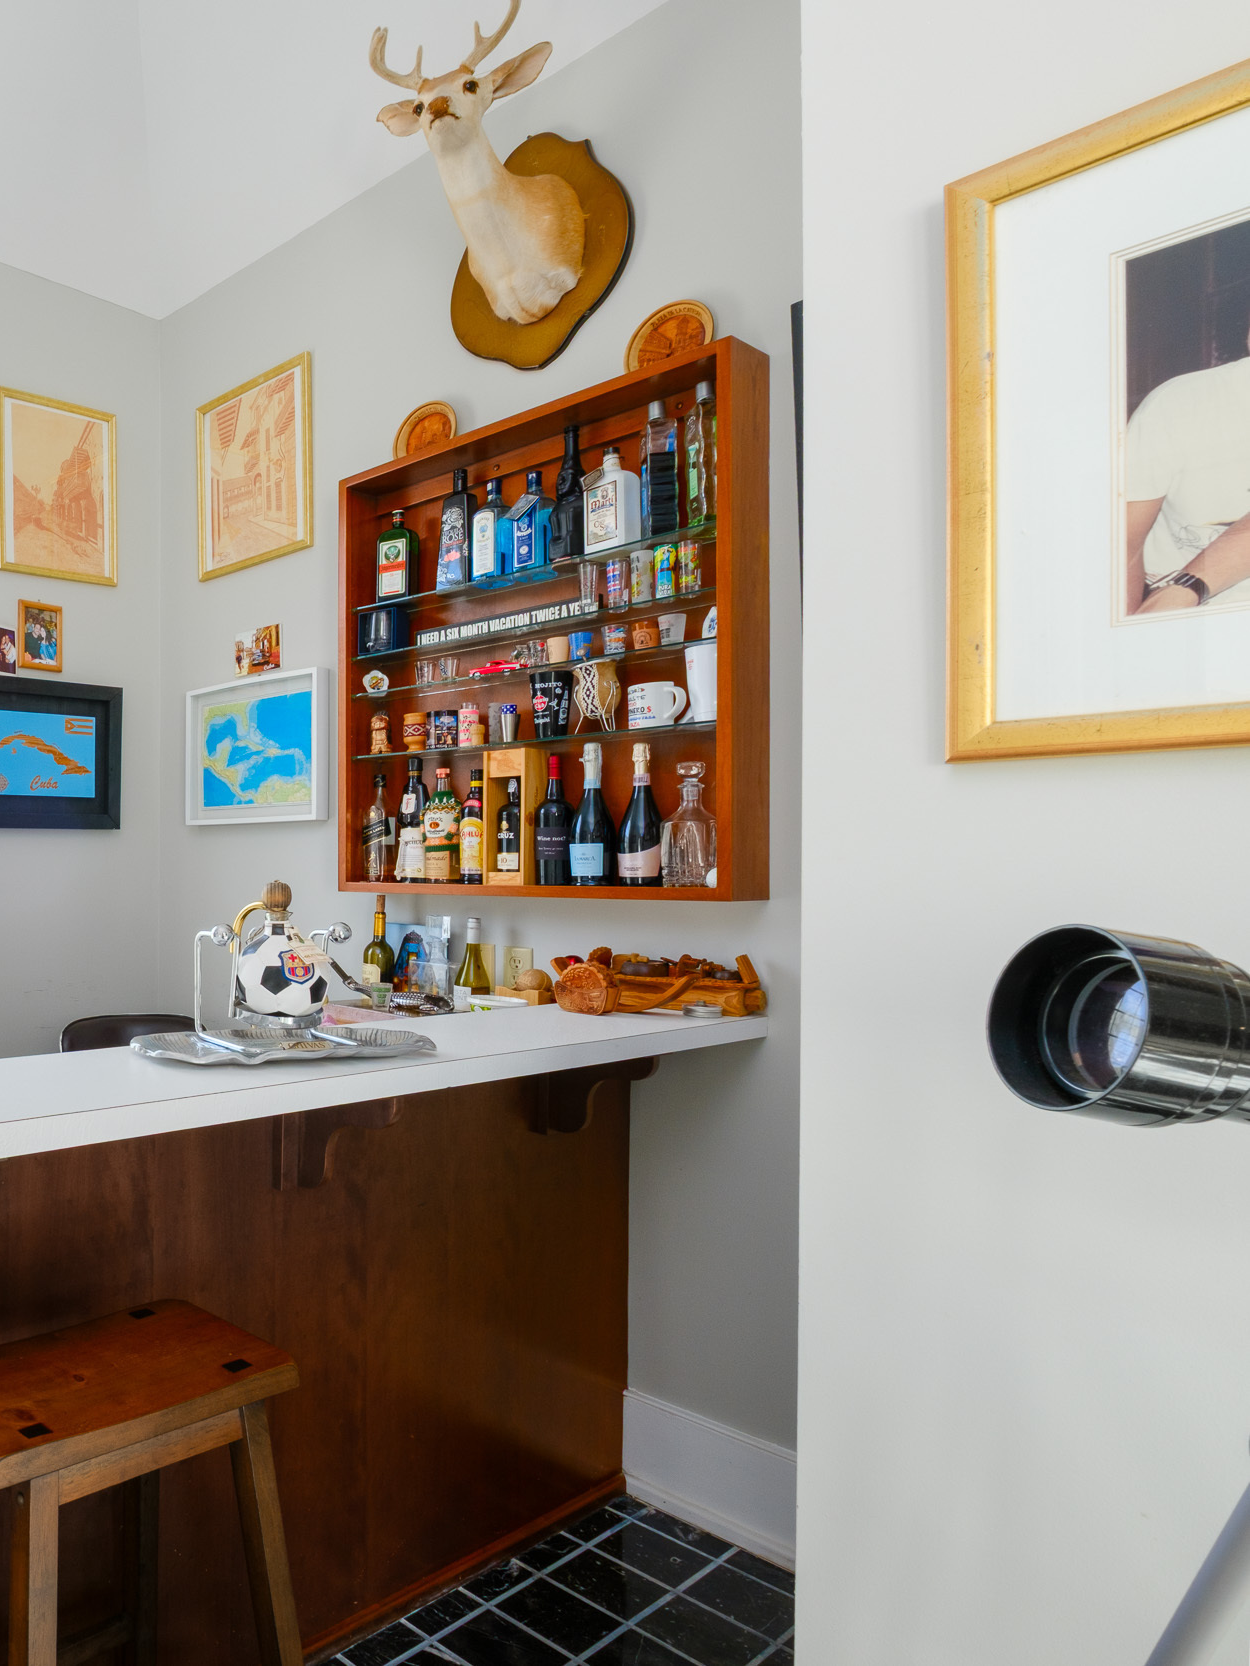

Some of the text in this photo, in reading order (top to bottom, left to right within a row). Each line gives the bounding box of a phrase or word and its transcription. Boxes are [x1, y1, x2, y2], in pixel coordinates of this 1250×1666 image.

[442, 532, 464, 545] ROSE
[417, 634, 421, 646] I
[421, 631, 440, 646] NEED
[440, 630, 446, 641] A
[446, 628, 460, 641] SIX
[460, 621, 489, 638] MONTH
[489, 614, 530, 632] VACATION
[531, 606, 560, 623] TWICE
[560, 604, 568, 618] A
[535, 681, 563, 689] MOJITO
[30, 775, 59, 792] Cuba
[287, 1041, 326, 1050] CHIVAS
